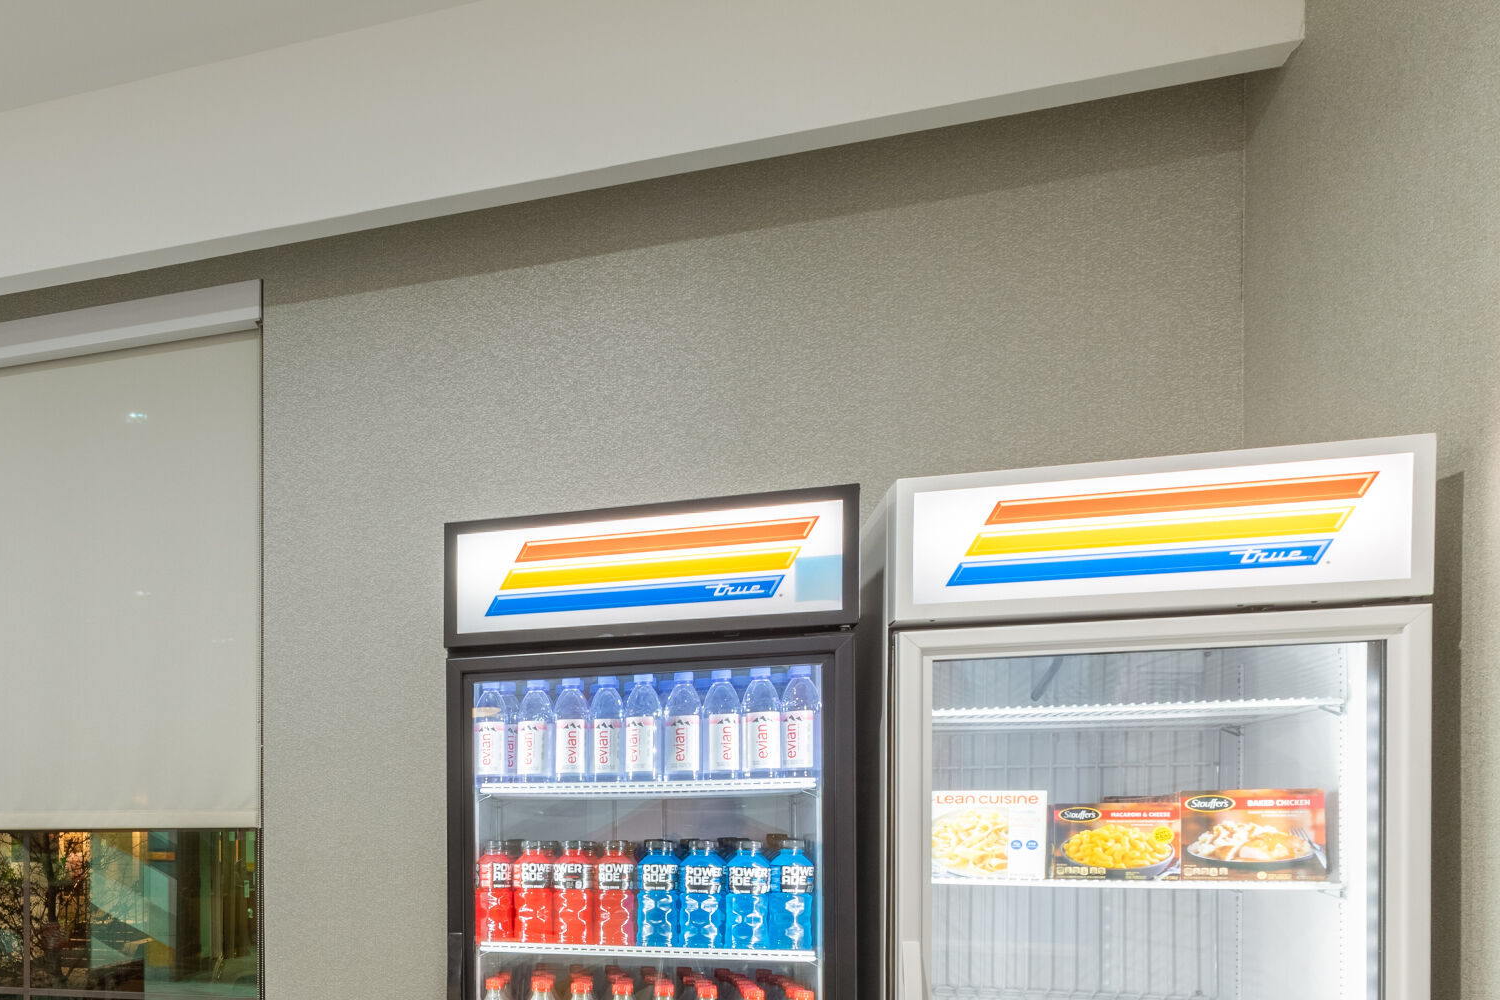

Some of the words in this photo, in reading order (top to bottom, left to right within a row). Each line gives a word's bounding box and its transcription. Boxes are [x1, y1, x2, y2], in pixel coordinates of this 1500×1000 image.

[1228, 549, 1308, 563] true
[705, 584, 765, 596] true
[628, 728, 638, 762] evian
[674, 727, 685, 762] evian
[721, 725, 732, 760] evian
[756, 723, 768, 759] evian
[787, 723, 797, 759] evian
[482, 733, 491, 765] evian
[566, 730, 577, 764] evian
[597, 730, 609, 764] evian
[936, 794, 976, 805] Lean
[1190, 798, 1229, 809] Stouffer's
[1247, 799, 1275, 807] BAKED
[1276, 799, 1311, 807] CHICKEN
[1063, 810, 1097, 820] Stouffer's
[521, 863, 551, 872] POWE
[553, 863, 582, 873] OWER
[729, 867, 768, 877] POWER
[781, 865, 814, 877] POWE
[598, 873, 620, 882] ADE
[643, 873, 666, 882] ADE
[685, 876, 709, 885] ADE
[781, 876, 806, 885] ADE
